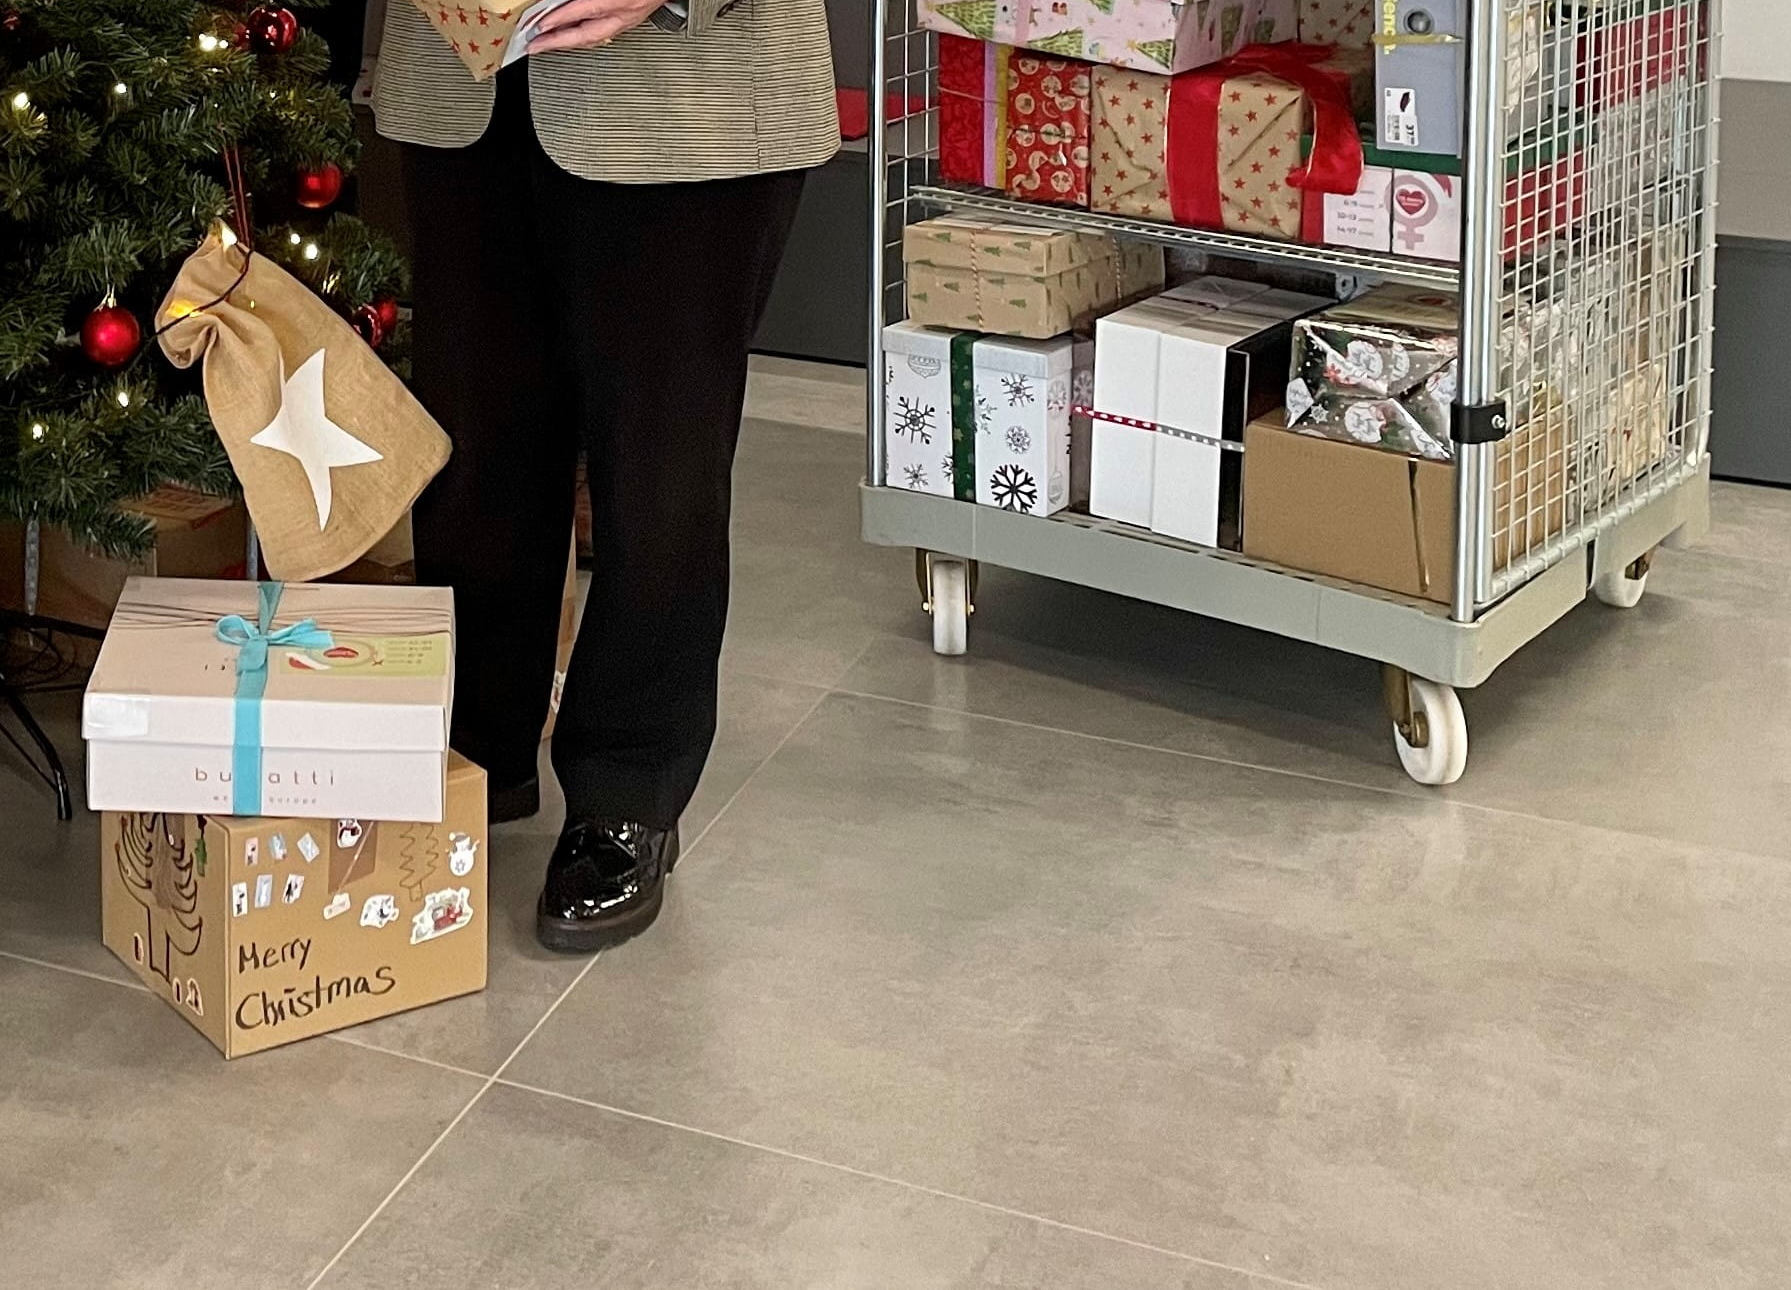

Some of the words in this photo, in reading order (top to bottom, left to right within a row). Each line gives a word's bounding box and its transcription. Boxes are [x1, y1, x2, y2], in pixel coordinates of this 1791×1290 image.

[195, 767, 334, 786] buatti
[239, 938, 312, 975] Merry
[235, 965, 396, 1030] Christmas
